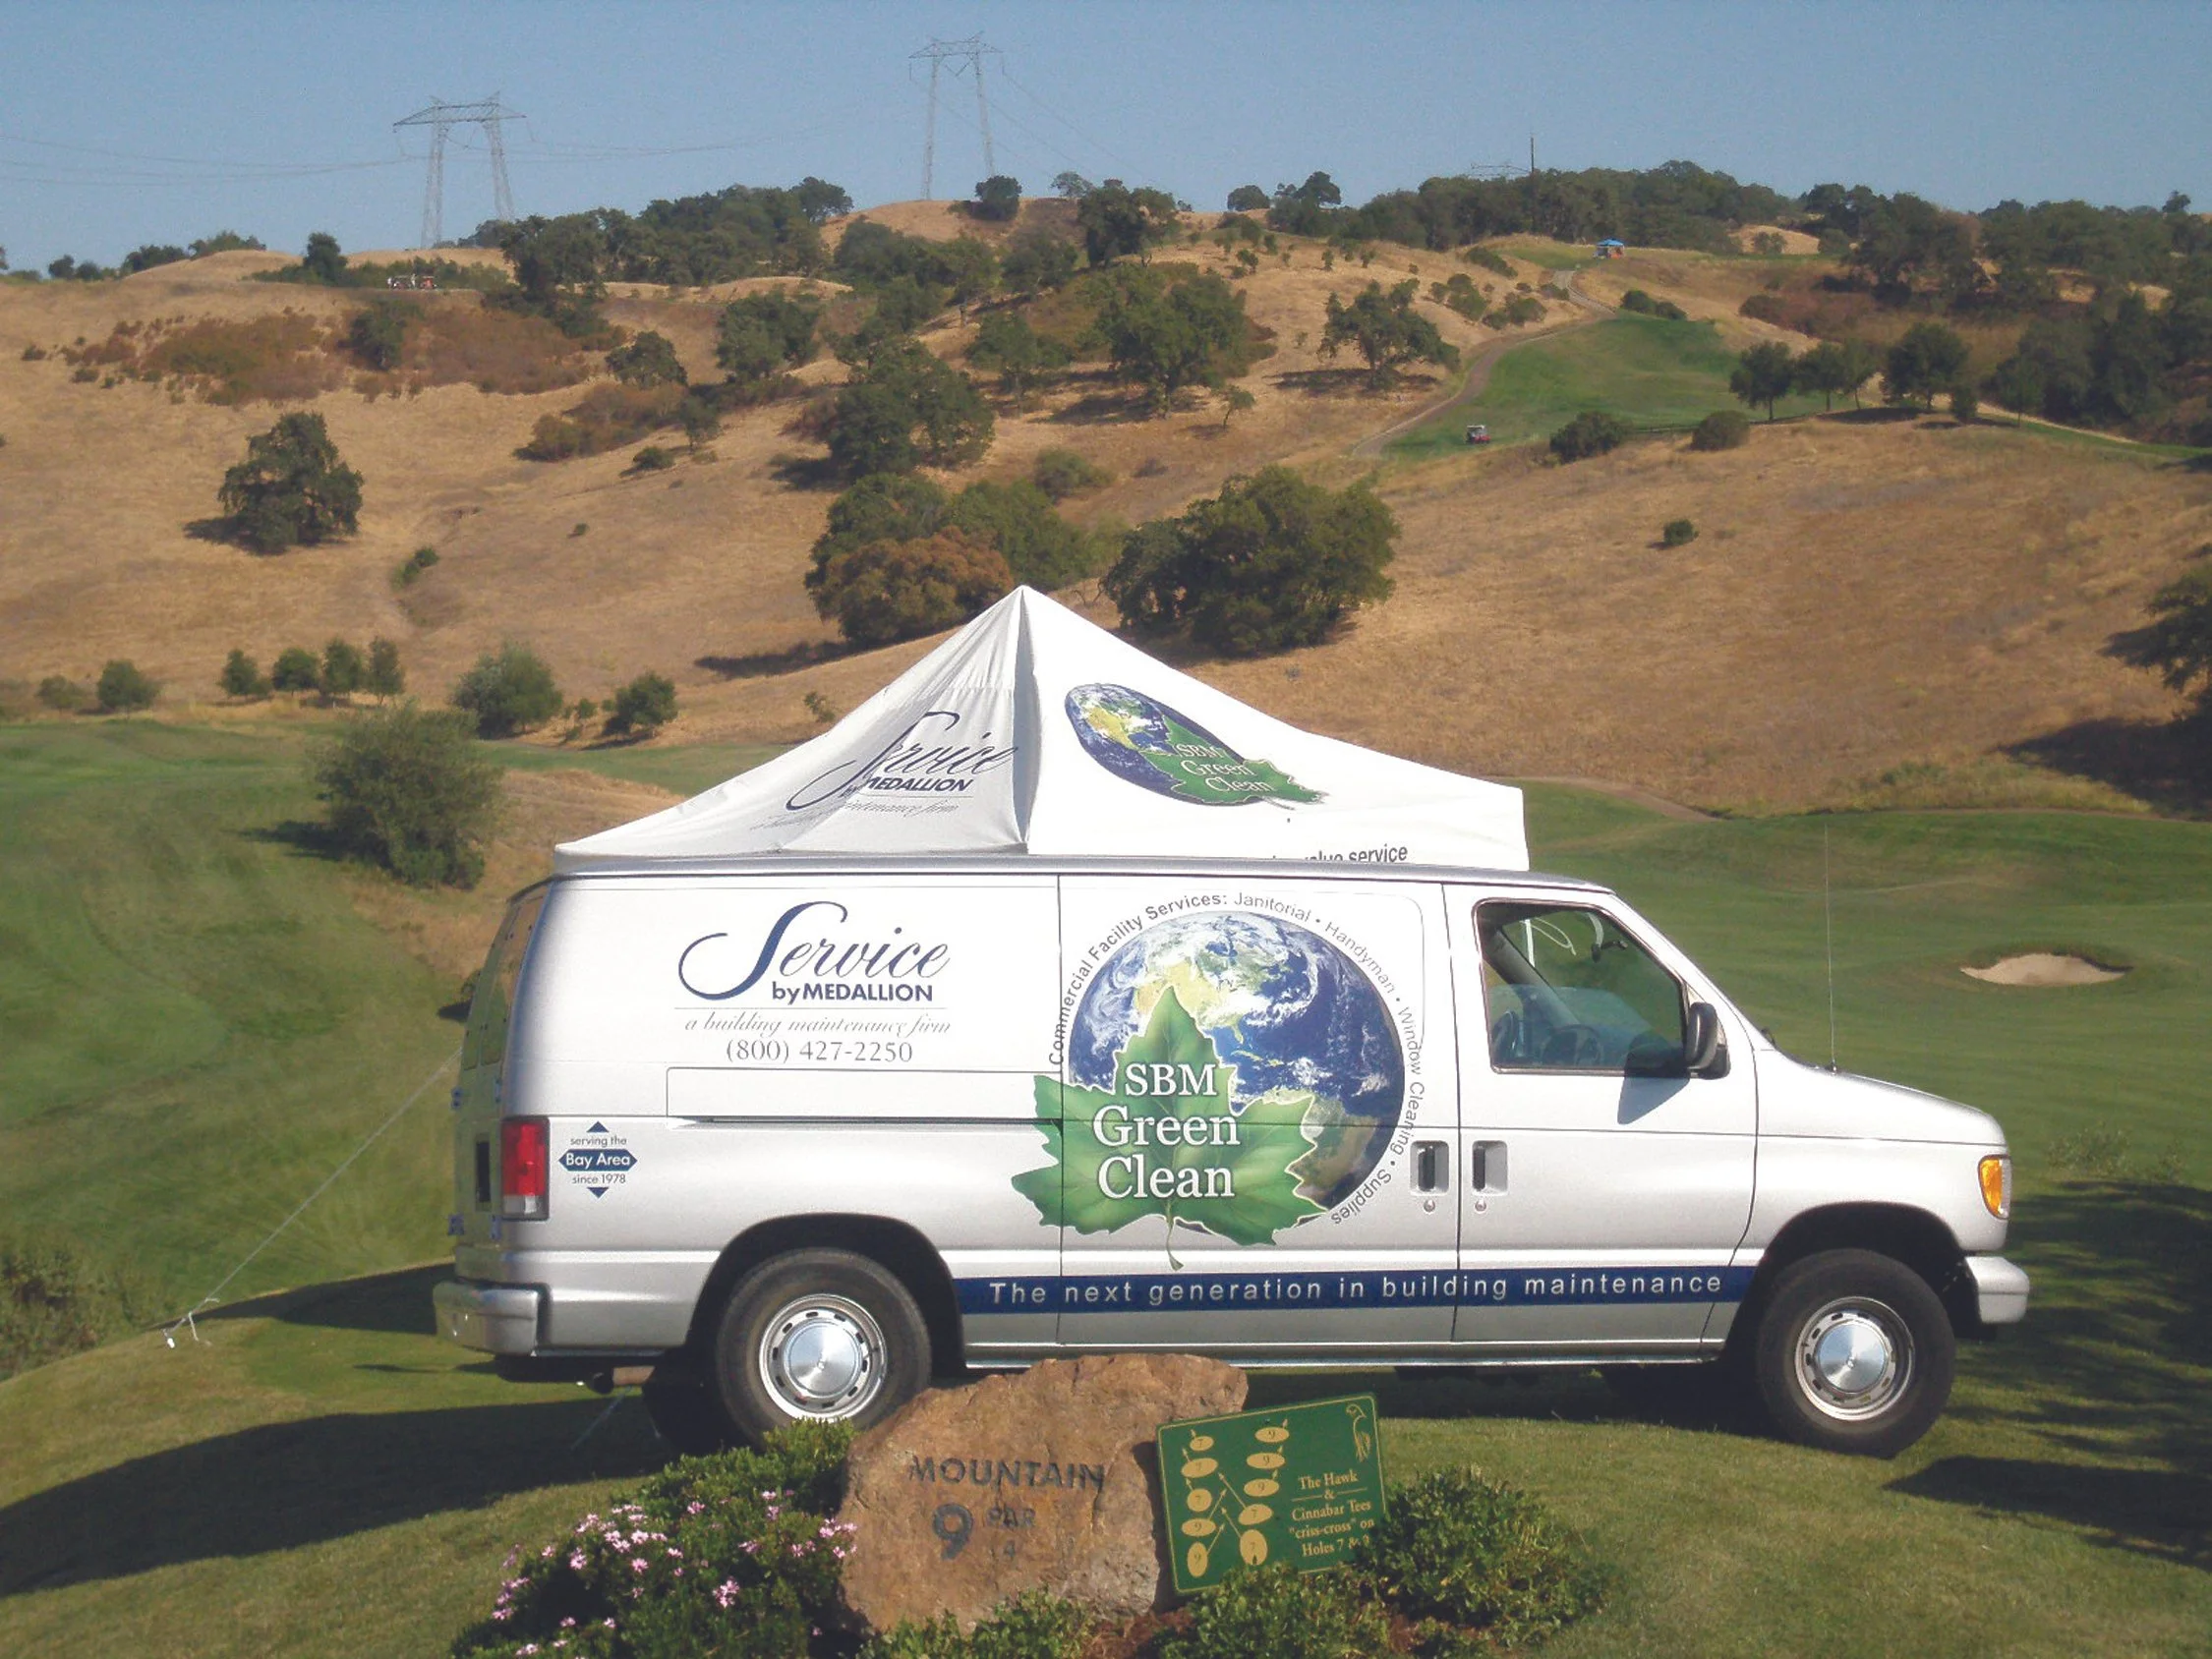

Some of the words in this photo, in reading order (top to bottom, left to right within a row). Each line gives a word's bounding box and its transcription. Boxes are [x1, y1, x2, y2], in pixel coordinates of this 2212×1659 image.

[1176, 744, 1224, 758] SBM
[1181, 760, 1256, 775] Green
[1205, 776, 1276, 791] Clean
[1349, 843, 1408, 863] service
[1145, 893, 1227, 920] Services:
[1235, 892, 1311, 922] Janitorial
[678, 901, 951, 1001] Service
[1087, 916, 1143, 961] Facility
[1324, 921, 1396, 994] Handyman
[772, 982, 800, 1004] by
[802, 983, 933, 1001] MEDALLION
[685, 1019, 698, 1031] a
[703, 1010, 782, 1038] building
[787, 1016, 908, 1034] maintenance
[897, 1012, 951, 1038] firm
[1049, 960, 1093, 1065] Commercial
[726, 1039, 789, 1062] (800)
[799, 1041, 912, 1061] 427-2250
[1398, 1006, 1422, 1075] Window
[1125, 1062, 1218, 1097] SBM
[1092, 1106, 1240, 1147] Green
[1389, 1081, 1425, 1156] Cleaning
[570, 1136, 608, 1148] serving
[611, 1135, 627, 1145] the
[566, 1153, 593, 1170] Bay
[596, 1153, 630, 1166] Area
[572, 1174, 599, 1184] since
[602, 1173, 626, 1184] 1978
[1098, 1155, 1235, 1198] Clean
[1331, 1169, 1392, 1224] Supplies
[989, 1283, 1046, 1304] The
[1065, 1282, 1133, 1302] next
[1148, 1279, 1321, 1306] generation
[1339, 1278, 1364, 1298] in
[1382, 1276, 1507, 1300] building
[1525, 1274, 1721, 1295] maintenance
[908, 1456, 1105, 1489] MOUNTAIN
[1299, 1475, 1321, 1490] The
[1323, 1468, 1359, 1486] Hawk
[1323, 1488, 1336, 1500] &
[1291, 1503, 1345, 1521] Cinnabar
[1347, 1499, 1371, 1513] Tees
[1360, 1518, 1374, 1529] on
[932, 1503, 973, 1561] 9
[1302, 1540, 1335, 1557] Holes
[1337, 1538, 1344, 1551] 7
